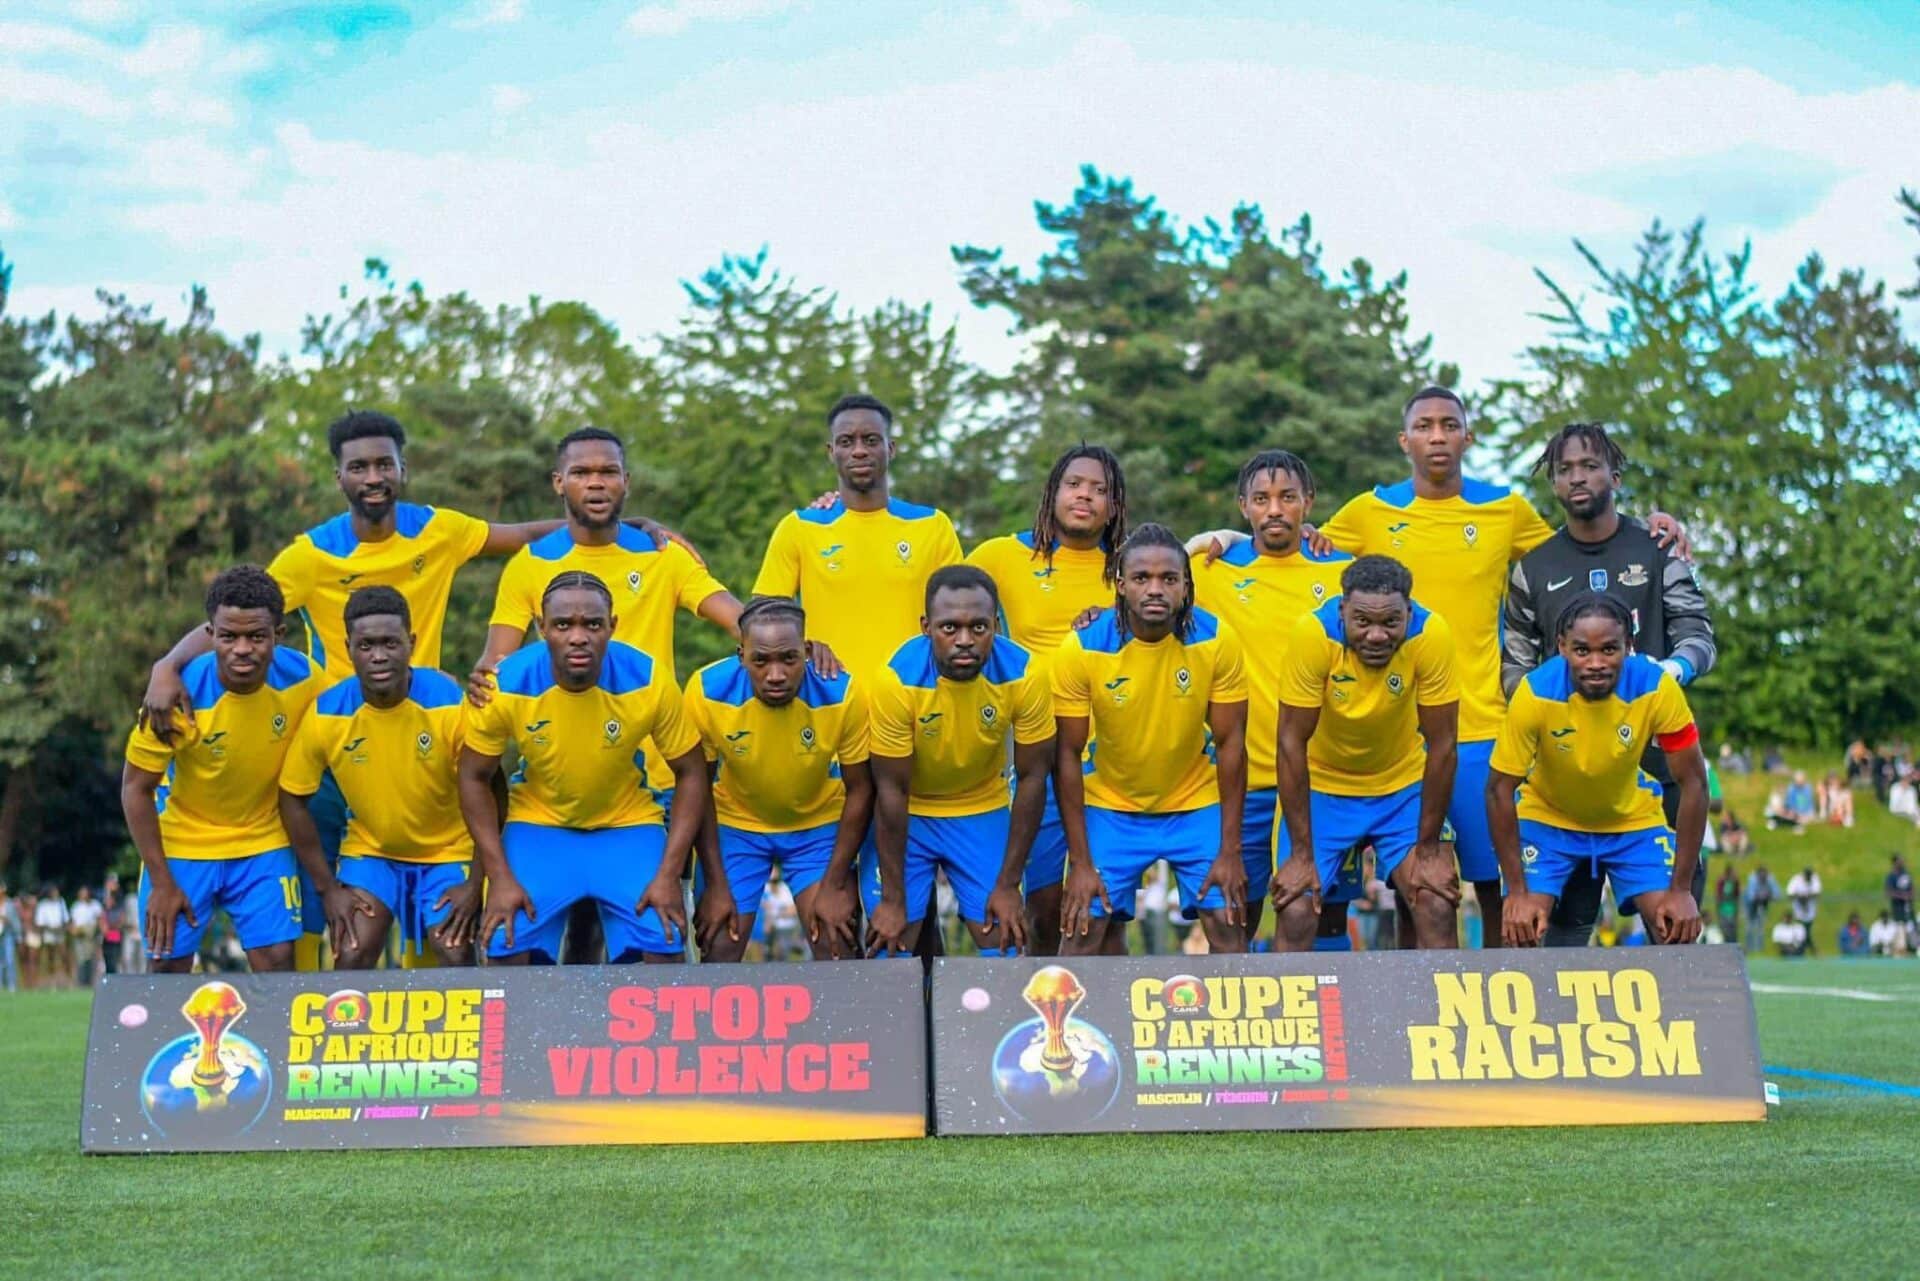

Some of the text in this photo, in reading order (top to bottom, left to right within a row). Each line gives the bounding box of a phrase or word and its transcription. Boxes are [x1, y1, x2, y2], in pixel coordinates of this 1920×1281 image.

[279, 875, 302, 910] 10
[291, 990, 481, 1033] COUPE
[607, 984, 812, 1041] STOP
[1131, 976, 1317, 1018] COUPE
[1433, 969, 1663, 1027] NO TO
[288, 1033, 480, 1063] D'AFRIQUE
[481, 1000, 505, 1096] NATIONS
[1133, 1018, 1321, 1048] D'AFRIQUE
[1320, 987, 1348, 1080] NATIONS
[1407, 1020, 1702, 1080] RACISM
[288, 1063, 478, 1099] RENNES
[547, 1042, 870, 1096] VIOLENCE
[1135, 1048, 1323, 1084] RENNES
[284, 1108, 351, 1121] MASCULIN
[1137, 1093, 1202, 1105] MASCULIN
